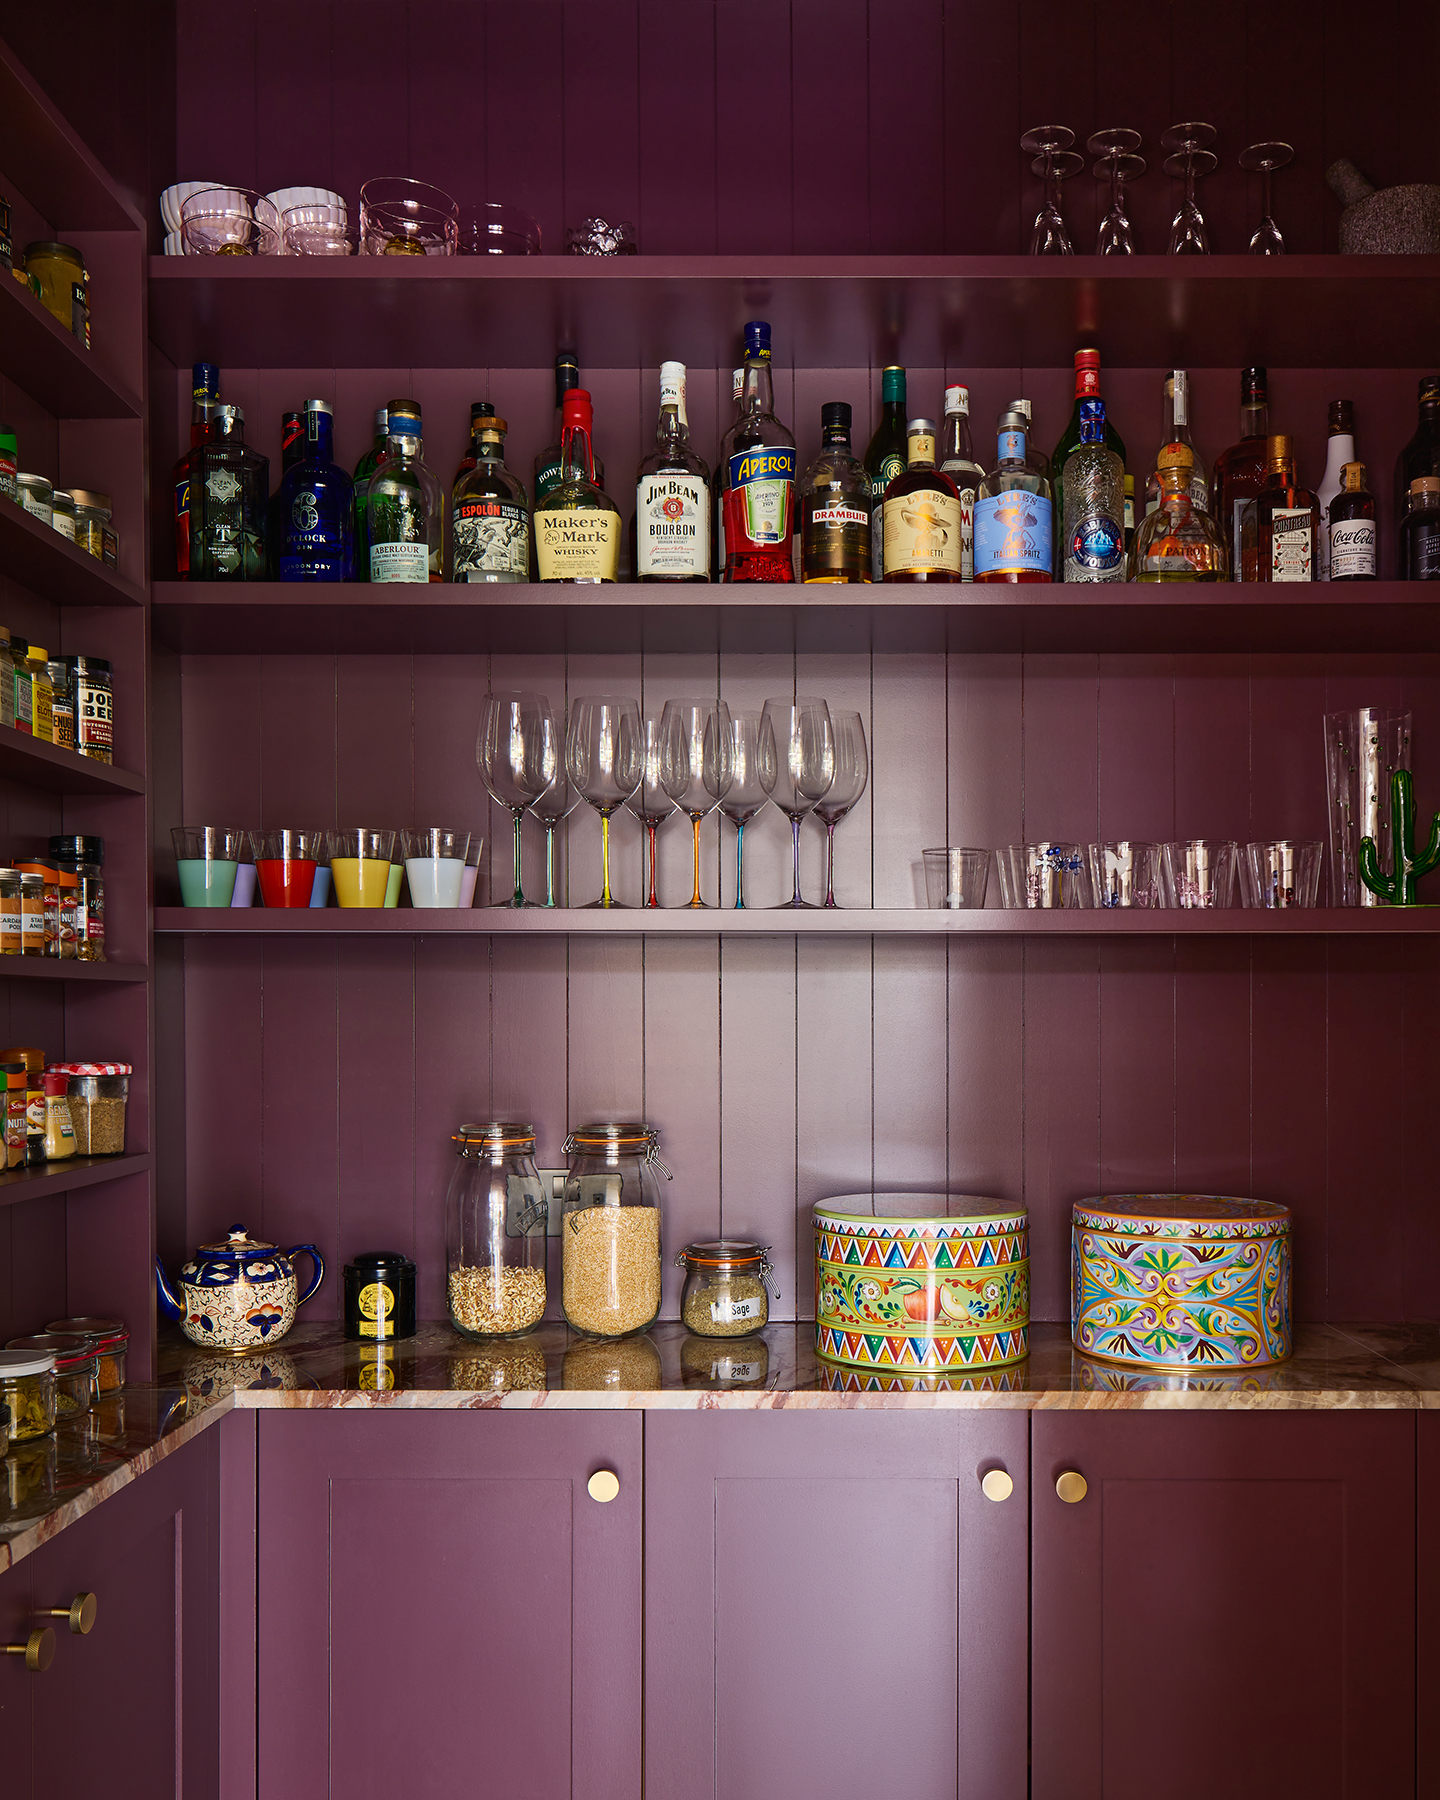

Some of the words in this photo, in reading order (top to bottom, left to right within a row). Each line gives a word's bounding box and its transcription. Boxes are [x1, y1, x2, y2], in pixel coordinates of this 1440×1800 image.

[738, 457, 792, 481] APEROL
[646, 485, 667, 505] JIM
[668, 481, 699, 505] BEAM
[906, 492, 948, 506] LYRE'S
[996, 492, 1039, 506] LYRE'S
[291, 491, 319, 532] 6
[814, 511, 868, 522] DRAMBUIE
[543, 517, 609, 528] Maker's
[1273, 514, 1311, 533] COINTREAU
[650, 524, 697, 536] BOURBON
[286, 533, 327, 543] O'CLOCK
[562, 531, 609, 543] Mark
[1333, 528, 1375, 548] Coca-Cola
[375, 545, 419, 555] ABERLOUR
[911, 549, 945, 557] AMARETTI
[993, 550, 1019, 559] ITALIAN
[1020, 550, 1041, 559] SPRITZ
[1083, 555, 1118, 568] VODKA
[373, 567, 380, 577] 14
[731, 1303, 750, 1316] Sage
